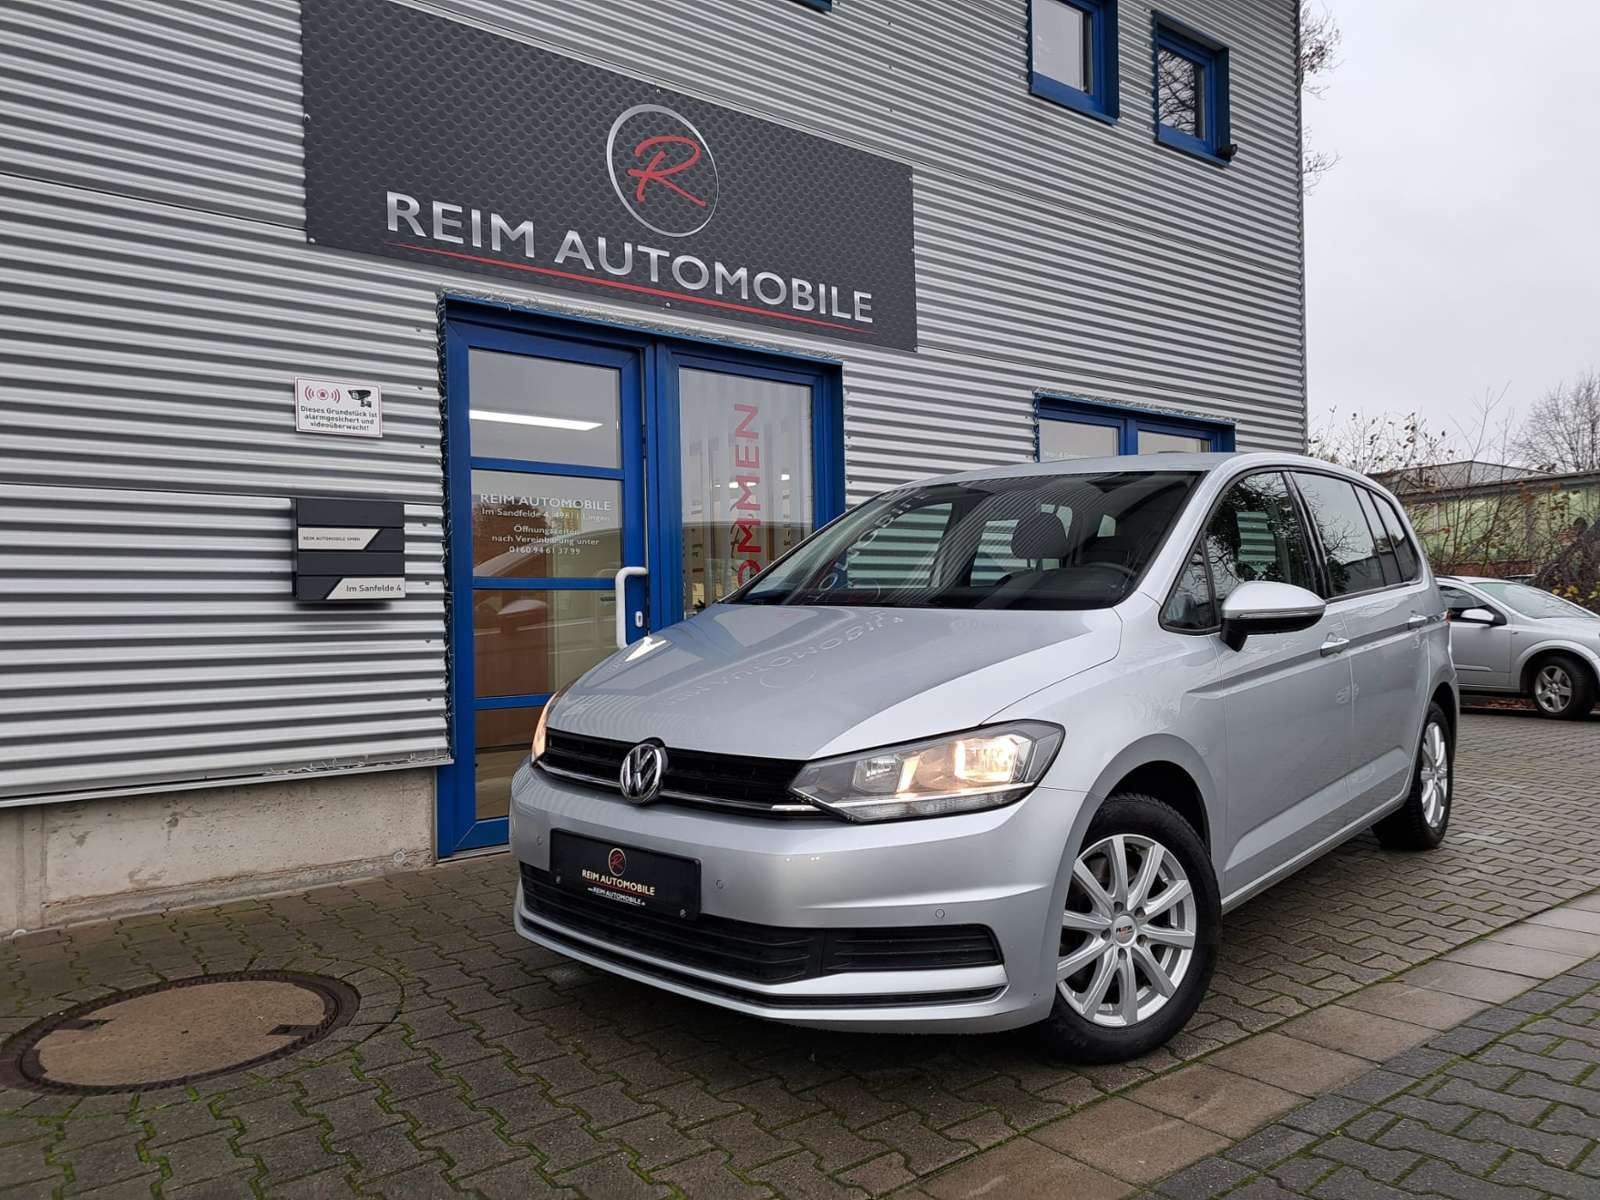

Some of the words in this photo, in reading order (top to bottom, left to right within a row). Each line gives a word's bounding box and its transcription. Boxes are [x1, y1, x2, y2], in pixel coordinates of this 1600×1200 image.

[628, 134, 706, 208] R
[386, 190, 536, 259] REIM
[554, 229, 874, 324] AUTOMOBILE
[300, 405, 325, 414] Dieses
[326, 408, 367, 418] Grundstück
[368, 411, 378, 419] ist
[304, 413, 360, 425] alarmgesichert
[361, 417, 375, 425] und
[480, 493, 515, 505] REIM
[518, 495, 612, 512] AUTOMOBILE
[481, 507, 495, 516] Im
[497, 508, 542, 519] Sandfelde
[491, 535, 514, 543] nach
[576, 538, 601, 546] unter
[346, 584, 358, 592] Im
[581, 869, 601, 881] REIM
[600, 875, 656, 896] AUTOMOBILE
